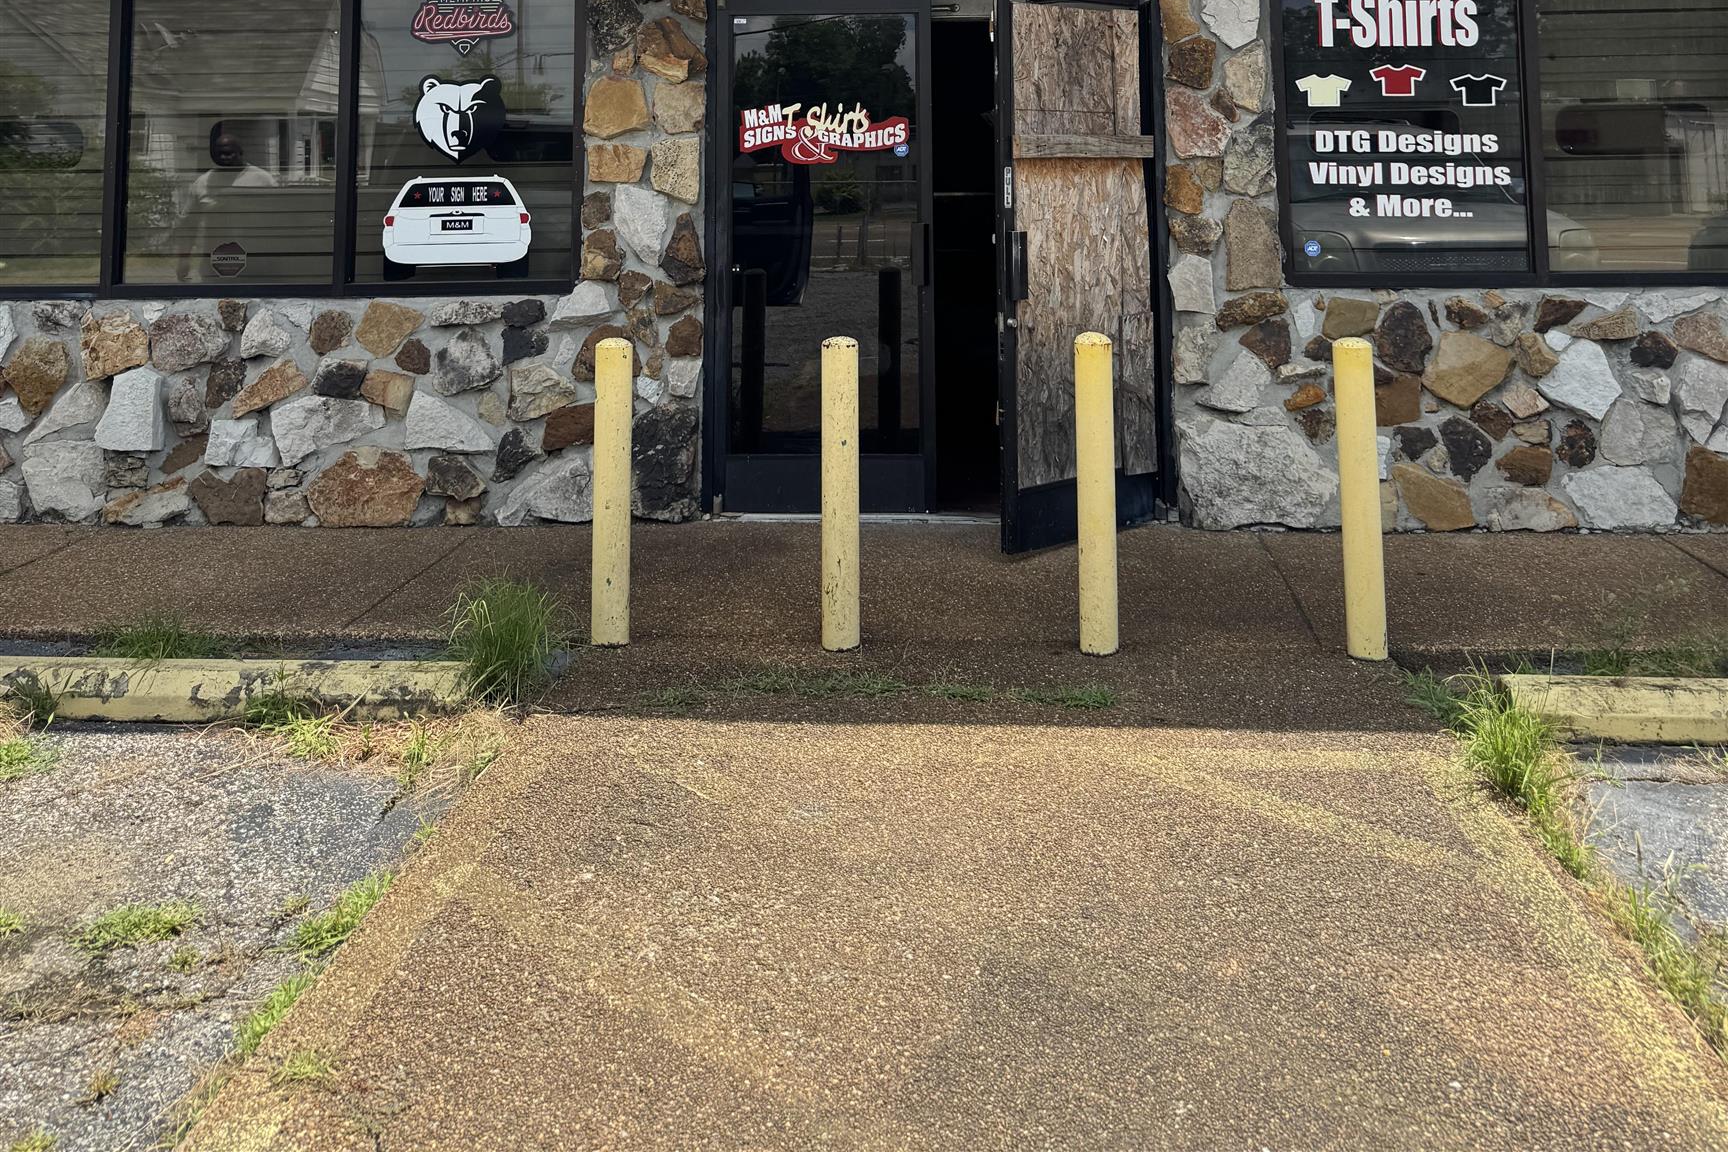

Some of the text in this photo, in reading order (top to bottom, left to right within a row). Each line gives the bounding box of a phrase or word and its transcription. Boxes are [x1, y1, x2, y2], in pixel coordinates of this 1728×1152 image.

[414, 5, 512, 34] Redbirds
[744, 104, 783, 129] M&M
[807, 102, 869, 134] Shirts
[744, 123, 906, 161] SIGNS & GRAPHICS
[1315, 130, 1499, 155] DTG Designs
[1309, 162, 1513, 188] Vinyl Designs
[428, 186, 488, 203] YOUR SIGN HERE
[1349, 194, 1474, 217] & More...
[446, 221, 470, 229] M&M
